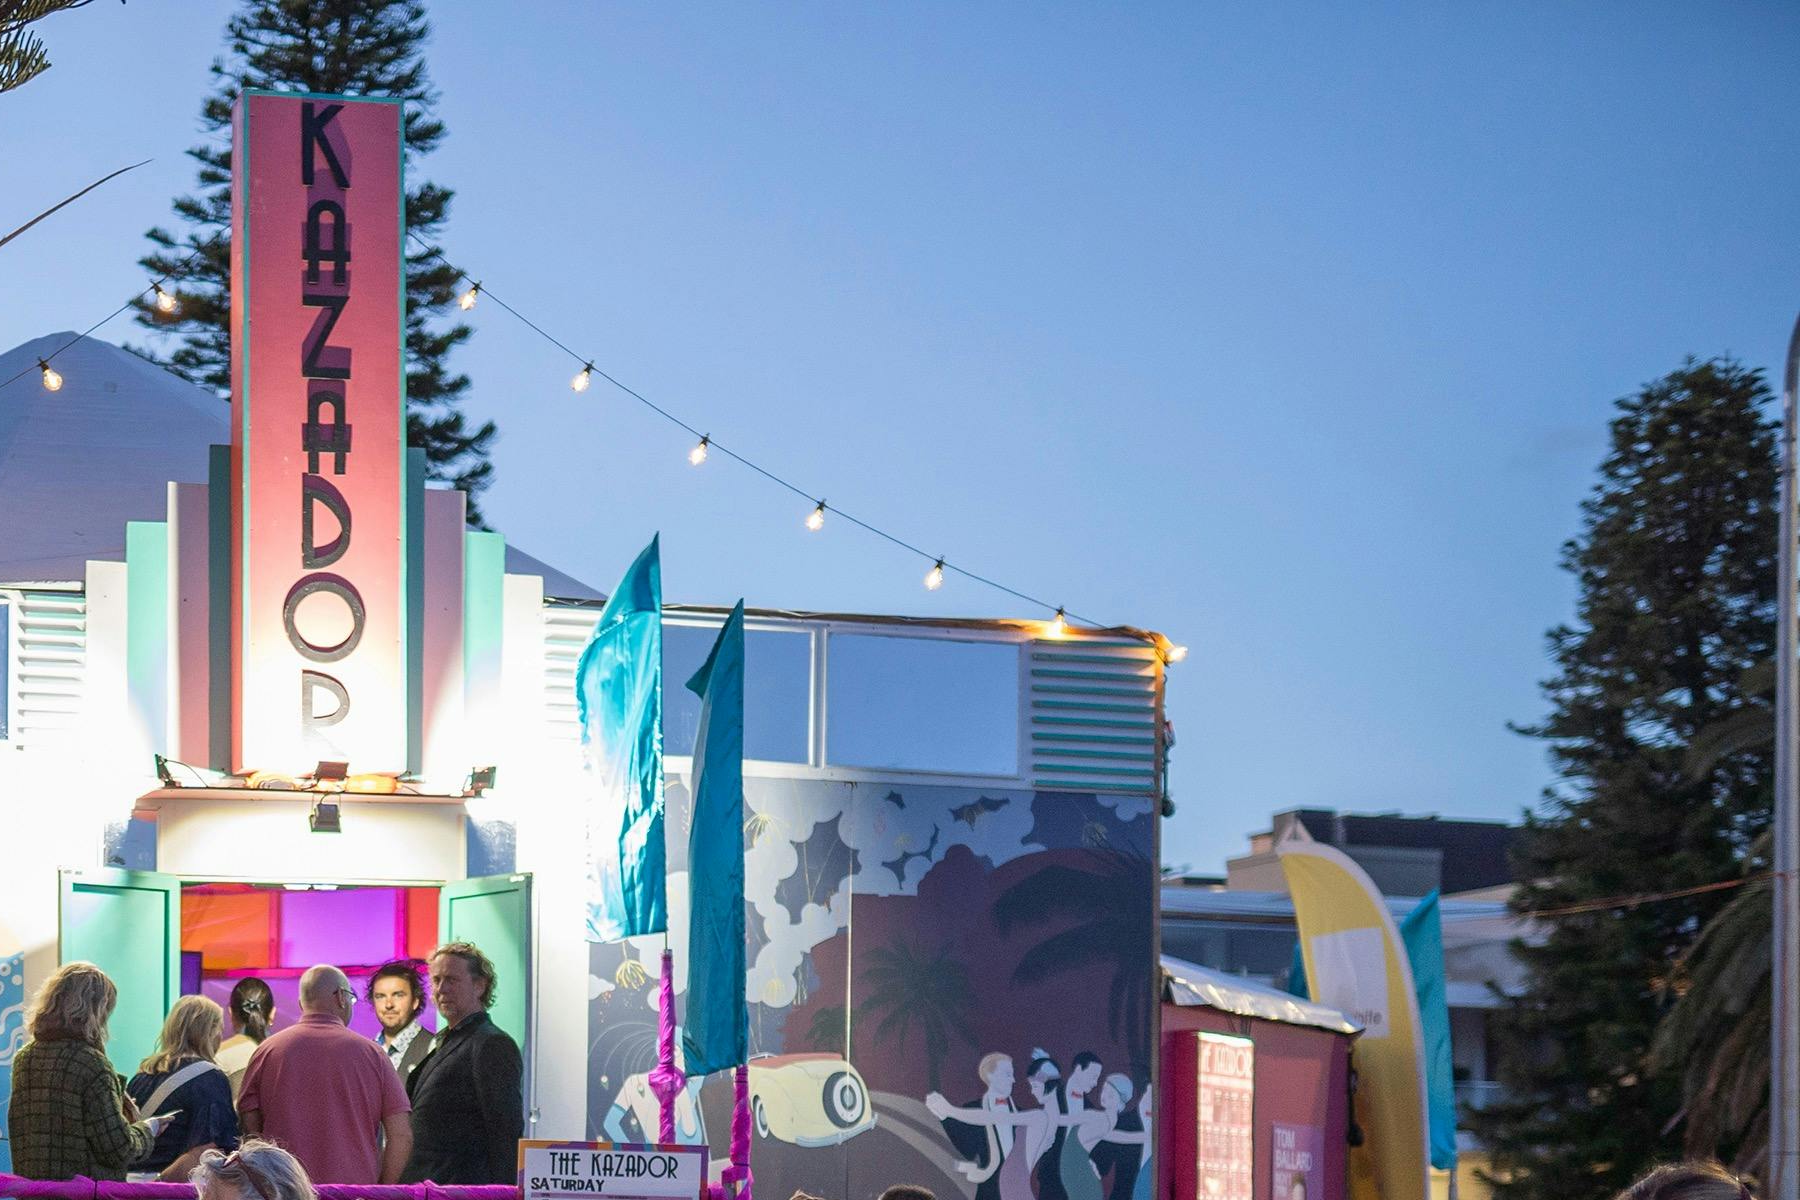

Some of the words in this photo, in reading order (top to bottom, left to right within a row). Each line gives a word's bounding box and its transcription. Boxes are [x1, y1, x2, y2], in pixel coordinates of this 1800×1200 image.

[283, 102, 366, 758] KAZADOR
[549, 1152, 581, 1176] THE
[591, 1153, 678, 1179] KAZADOR
[531, 1177, 605, 1192] SATURDAY
